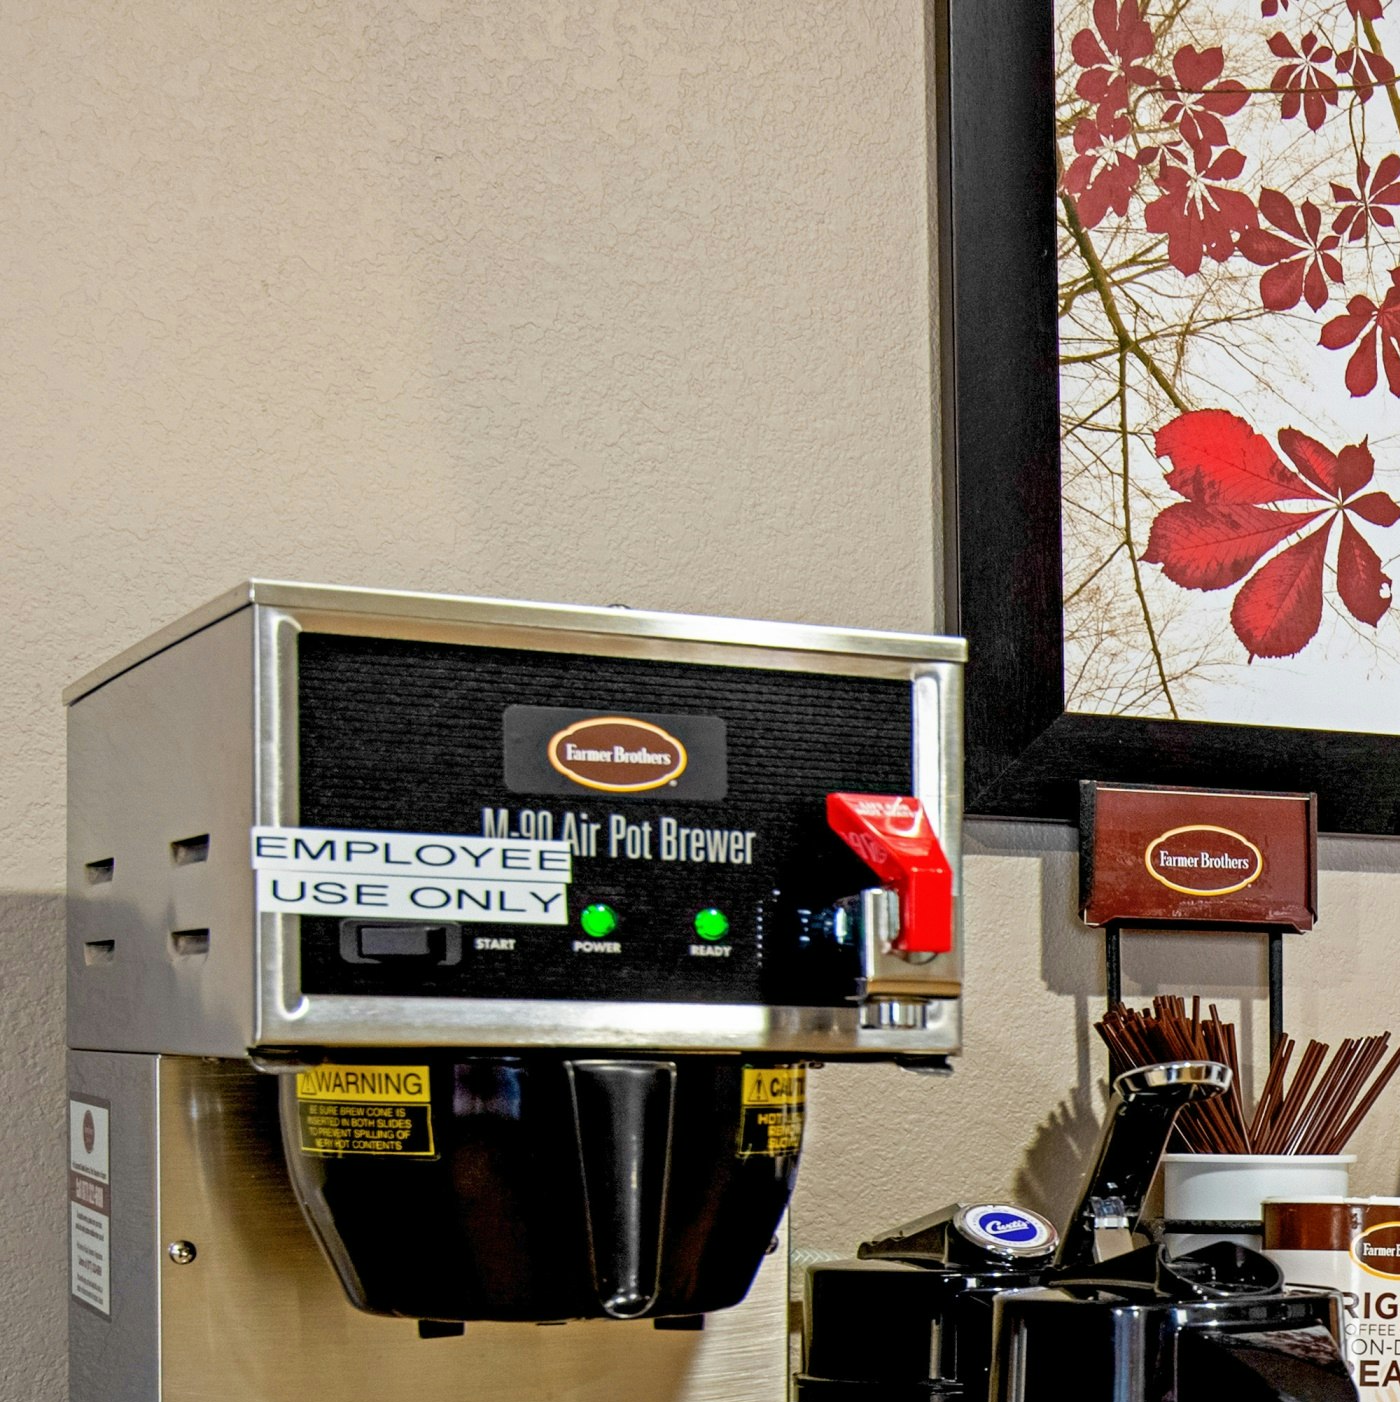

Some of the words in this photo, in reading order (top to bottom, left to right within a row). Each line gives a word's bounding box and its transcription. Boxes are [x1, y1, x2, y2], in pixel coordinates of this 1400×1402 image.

[565, 743, 613, 762] Farmer
[614, 745, 672, 765] Brothers
[562, 812, 601, 857] Air
[609, 814, 652, 860] Pot
[660, 816, 757, 864] Brewer
[256, 836, 571, 872] EMPLOYEE
[1160, 850, 1199, 868] Farmer
[1201, 852, 1249, 869] Brothers
[271, 880, 389, 906] USE
[410, 886, 562, 913] ONLY
[475, 938, 516, 951] START
[574, 940, 622, 953] POWER
[690, 944, 732, 957] READY
[316, 1071, 422, 1095] WARNING
[320, 1105, 339, 1116] SURE
[340, 1107, 365, 1116] BREW
[366, 1107, 394, 1117] CONE
[395, 1108, 406, 1118] IS
[341, 1118, 350, 1127] IN
[351, 1118, 376, 1128] BOTH
[376, 1119, 412, 1129] SLIDES
[318, 1127, 352, 1138] PREVENT
[354, 1129, 395, 1140] SPILLING
[396, 1130, 411, 1140] OF
[352, 1140, 403, 1151] CONTENTS
[985, 1219, 1030, 1235] Curtis
[1363, 1242, 1395, 1257] Farmer
[1344, 1324, 1395, 1336] OFFEE
